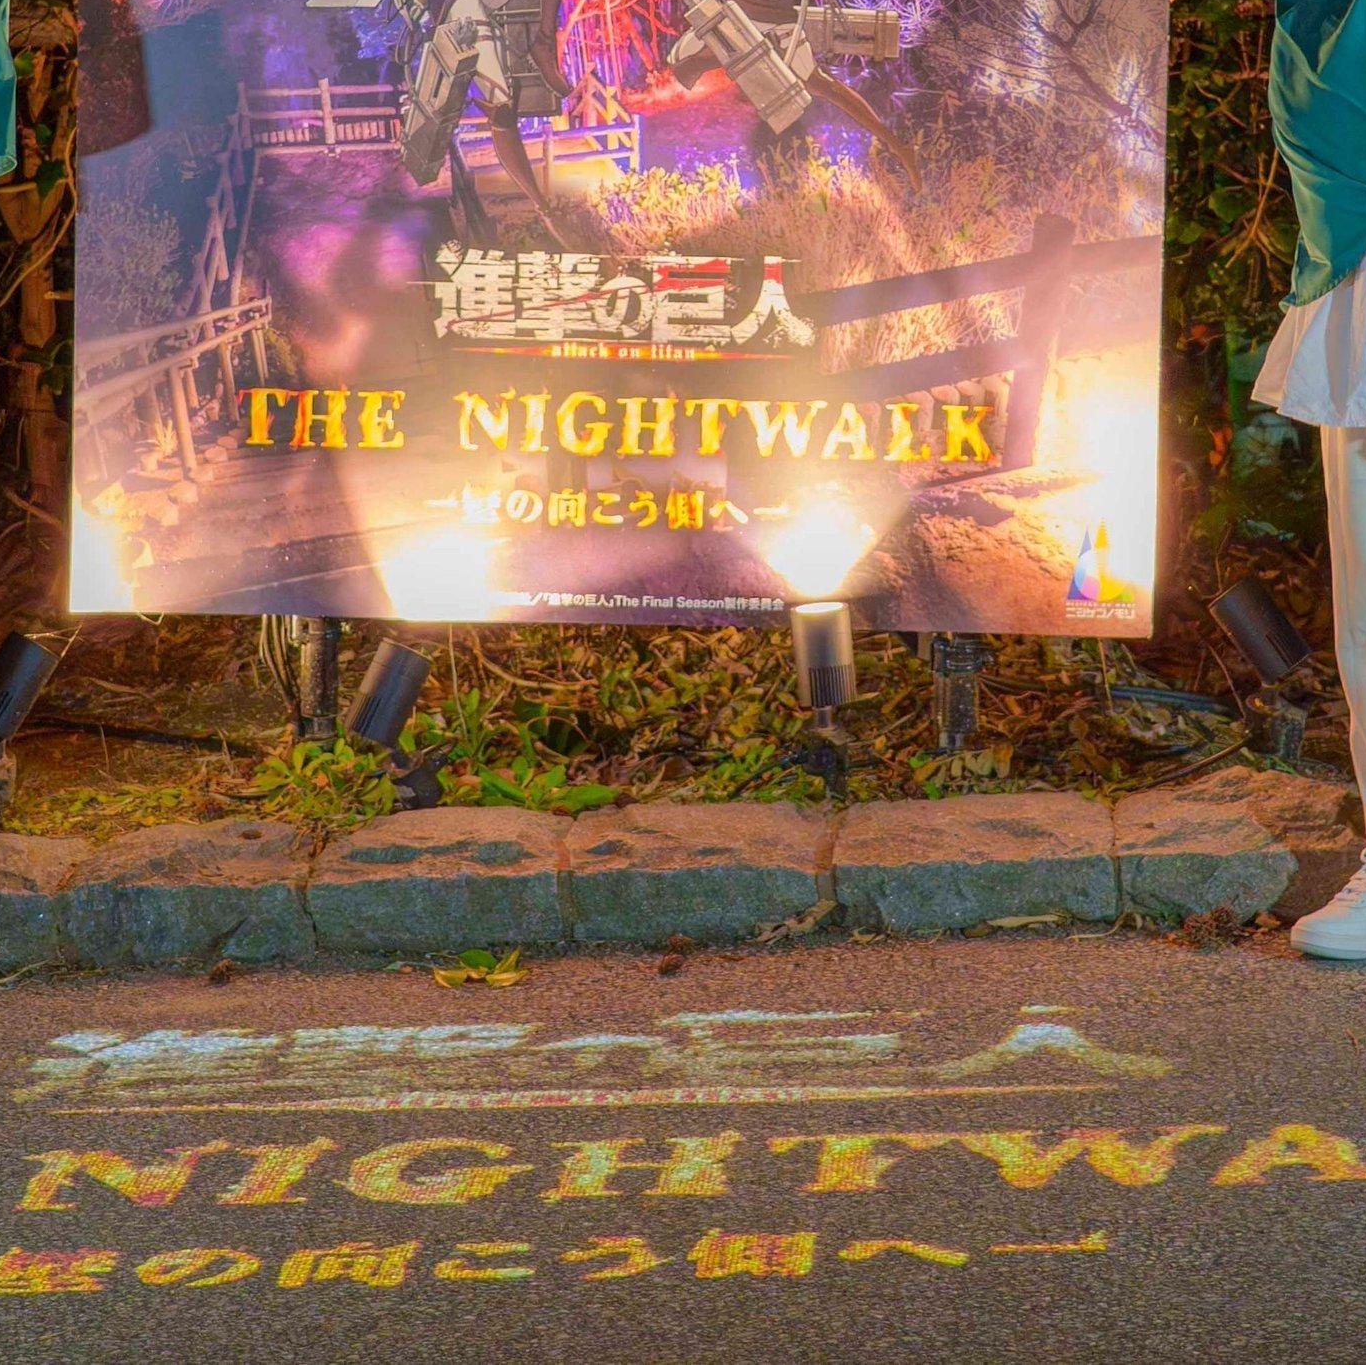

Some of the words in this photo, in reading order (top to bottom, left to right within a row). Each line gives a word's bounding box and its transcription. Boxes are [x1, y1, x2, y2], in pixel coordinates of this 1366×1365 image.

[433, 238, 816, 346] 進撃の巨人
[236, 386, 406, 449] THE
[452, 384, 997, 466] NIGHTWALK
[642, 595, 674, 610] Final
